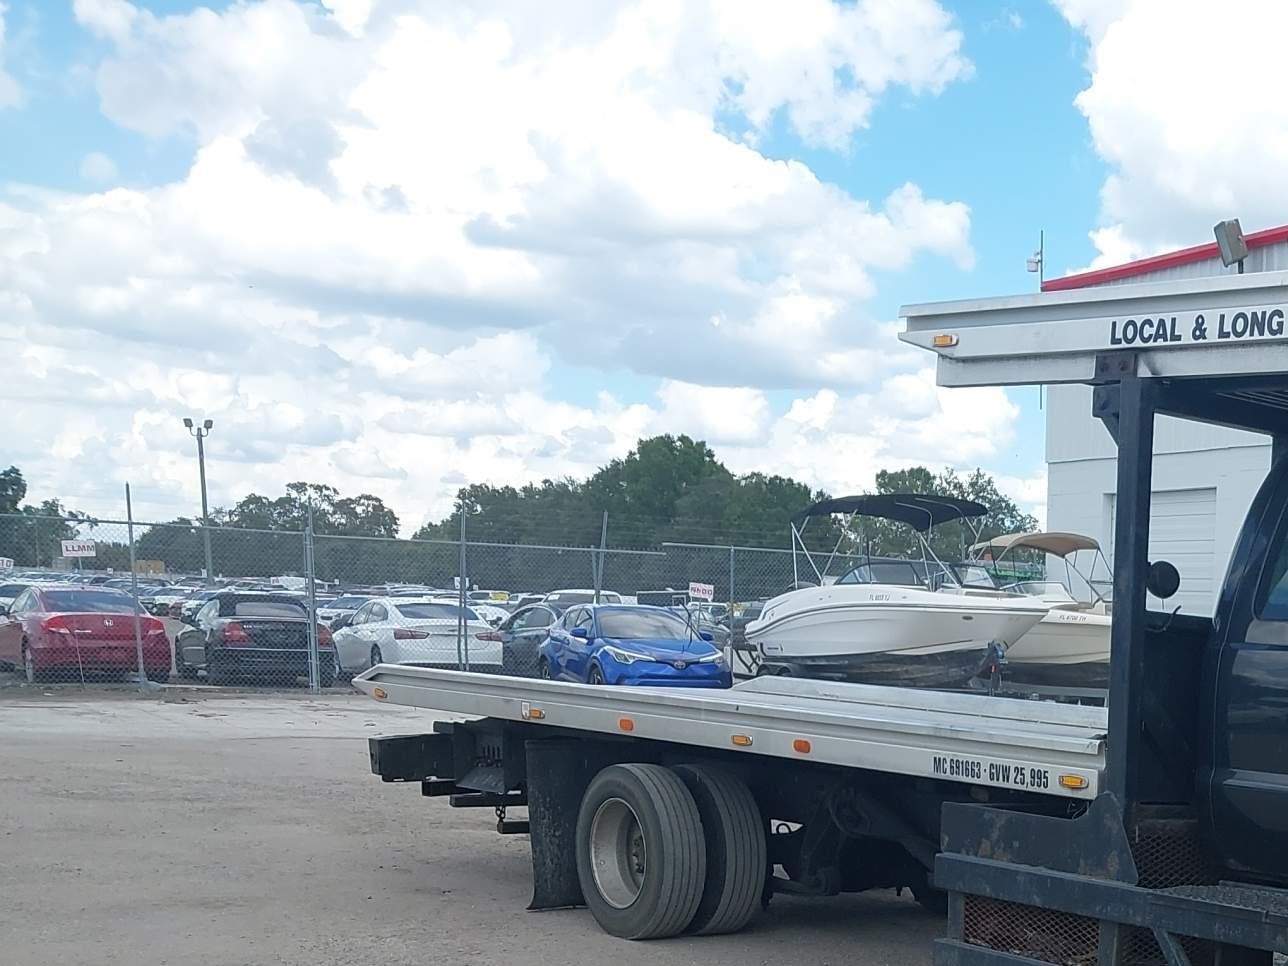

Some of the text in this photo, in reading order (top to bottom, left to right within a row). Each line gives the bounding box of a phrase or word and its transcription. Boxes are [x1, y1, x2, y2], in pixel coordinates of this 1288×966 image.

[1110, 317, 1182, 345] LOCAL
[1192, 314, 1208, 340] &
[1217, 309, 1285, 339] LONG
[933, 756, 948, 775] MC
[949, 758, 981, 779] 691663
[989, 762, 1011, 784] GVW
[1013, 766, 1049, 789] 25,995
